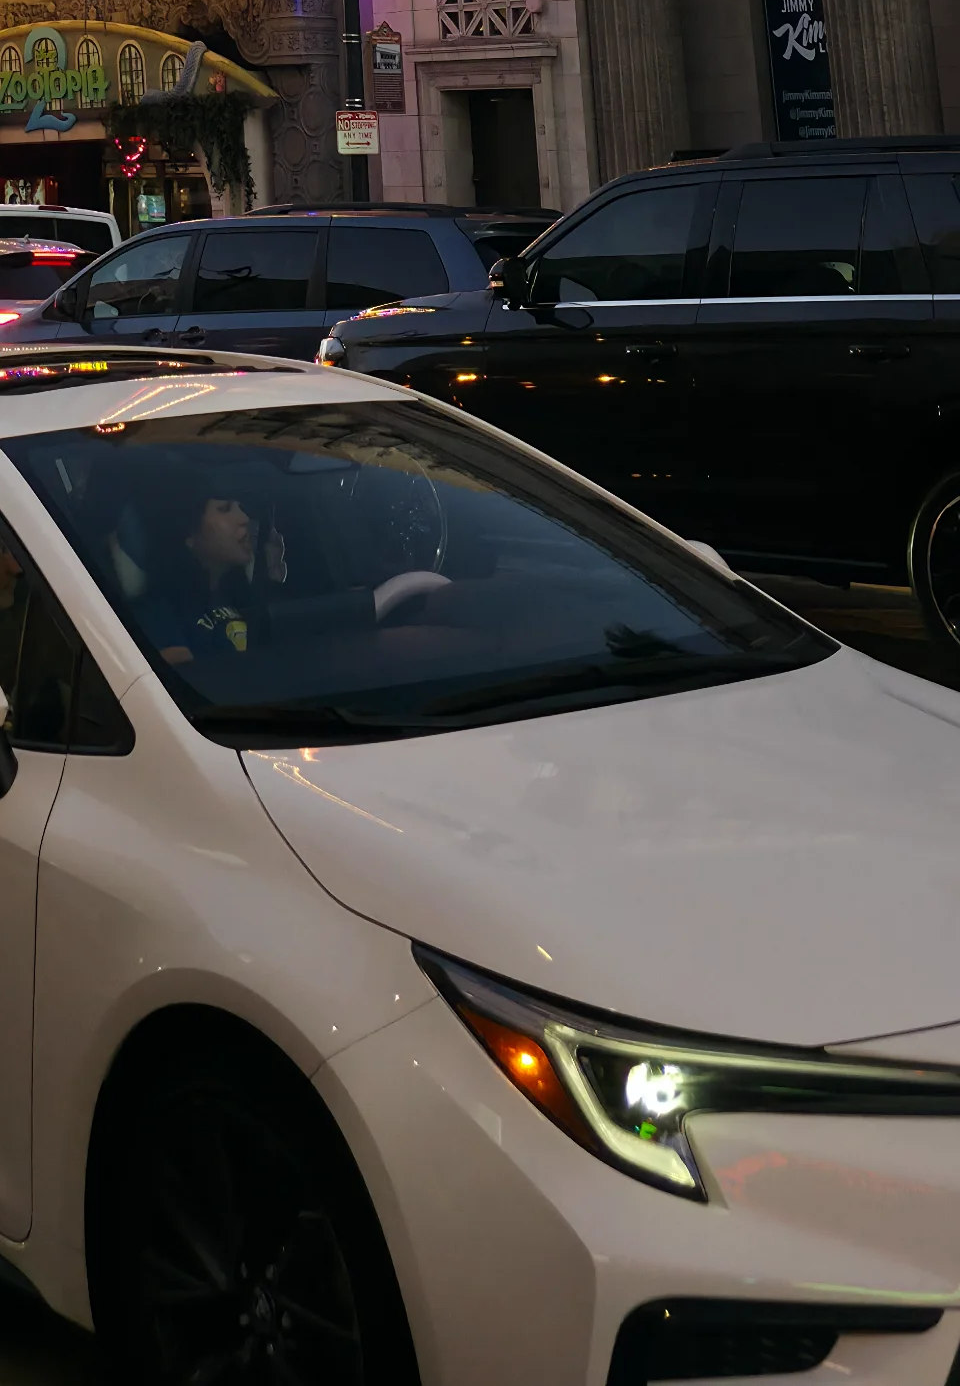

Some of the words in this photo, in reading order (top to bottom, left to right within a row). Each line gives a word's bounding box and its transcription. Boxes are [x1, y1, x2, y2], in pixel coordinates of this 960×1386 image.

[772, 12, 827, 61] Kim
[789, 107, 834, 121] @JimmyKim
[338, 120, 350, 131] NO
[798, 125, 836, 139] @JimmyKi
